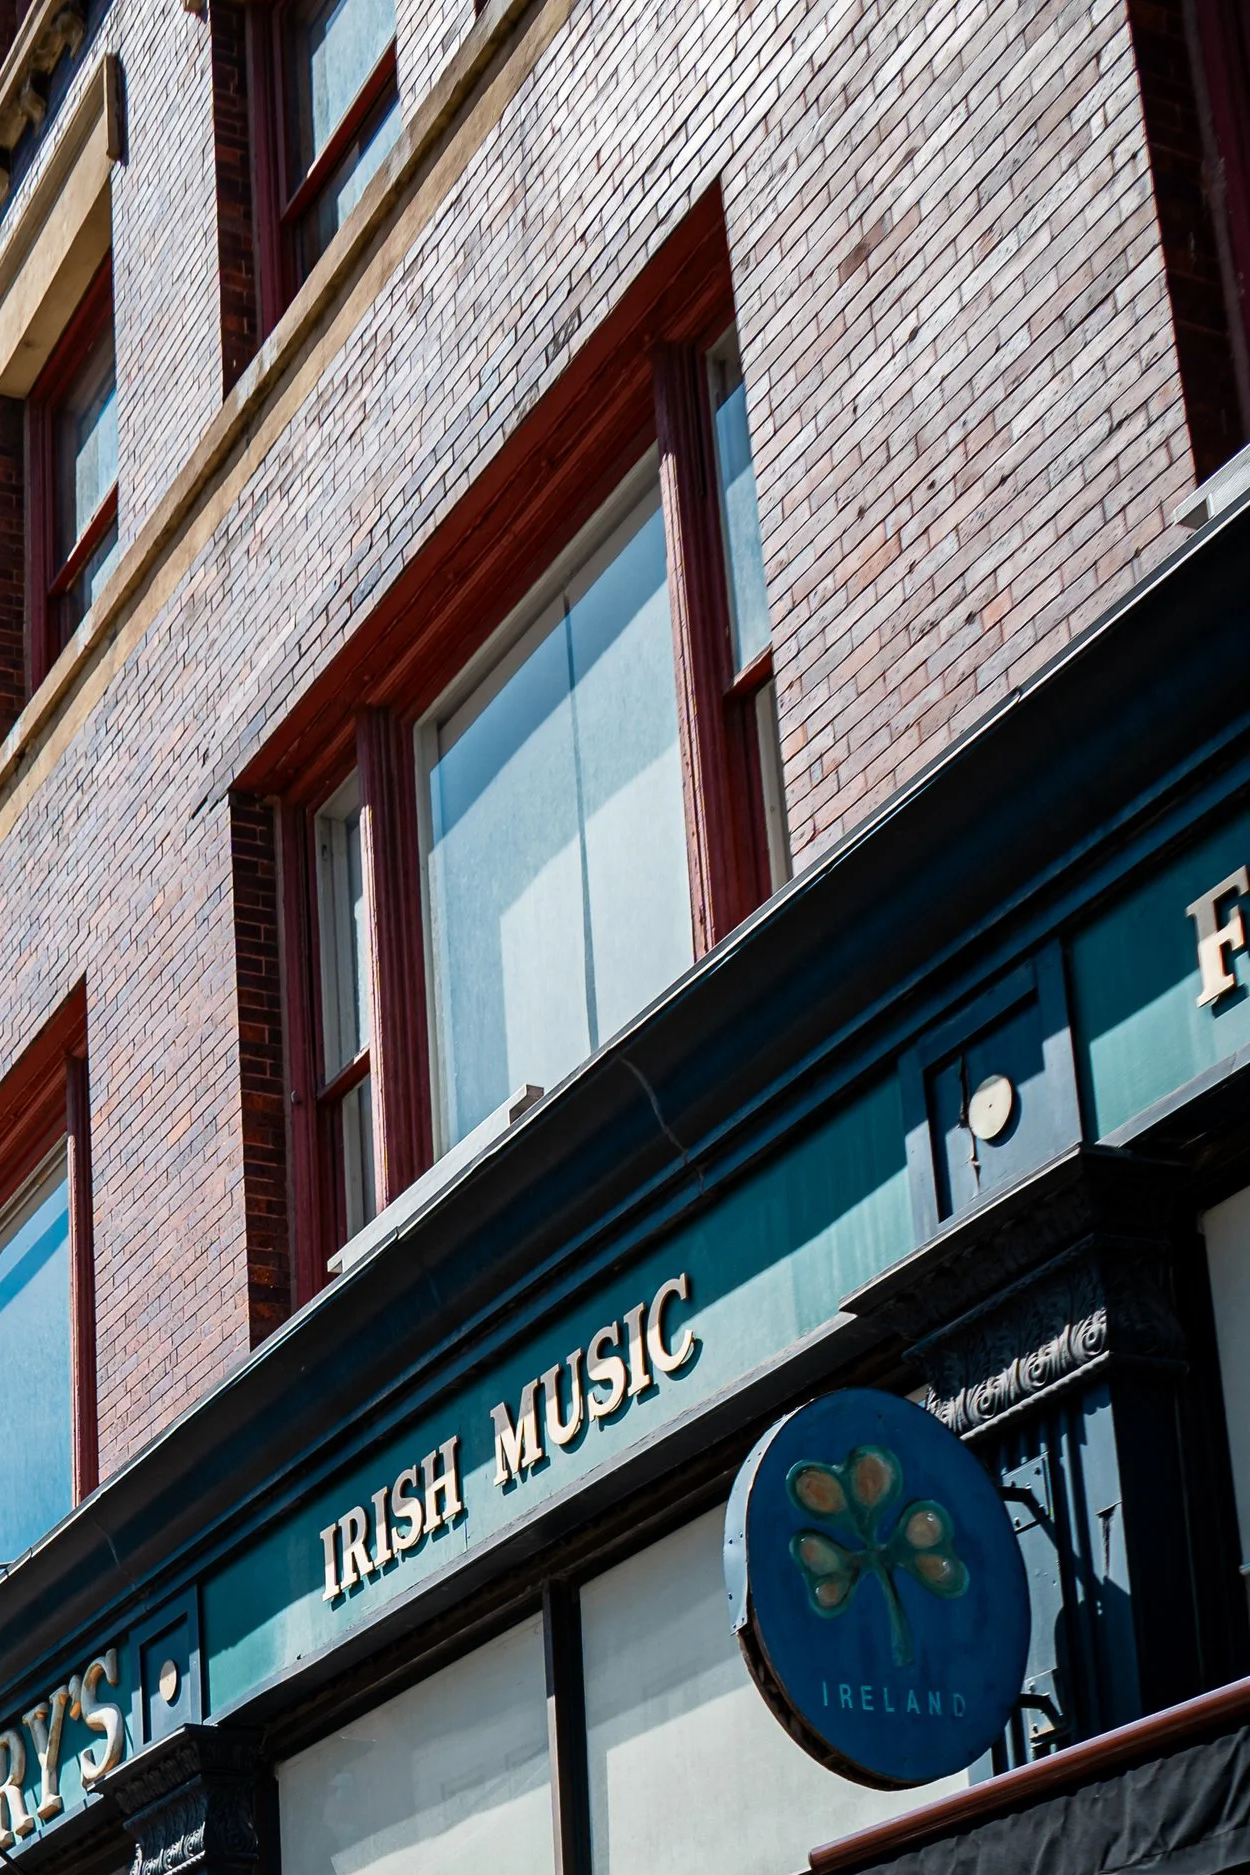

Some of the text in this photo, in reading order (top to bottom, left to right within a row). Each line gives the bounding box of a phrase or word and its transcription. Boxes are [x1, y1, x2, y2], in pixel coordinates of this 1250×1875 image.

[319, 1272, 695, 1602] IRISH MUSIC
[822, 1681, 966, 1717] IRELAND
